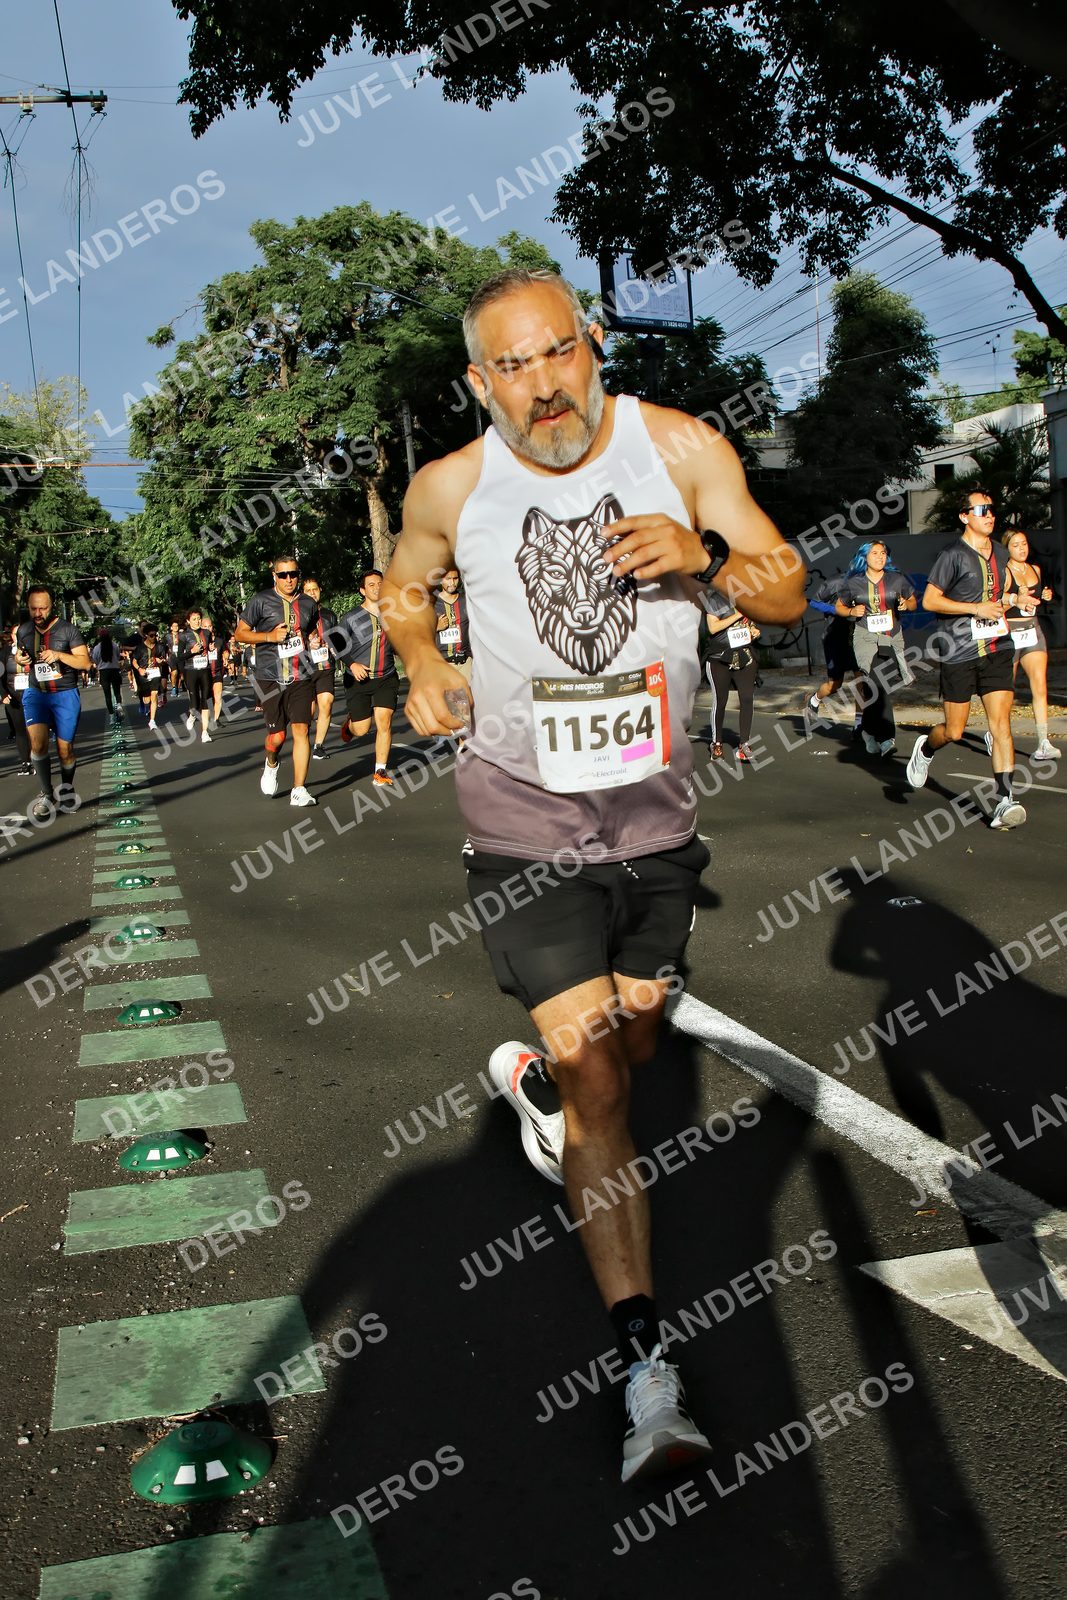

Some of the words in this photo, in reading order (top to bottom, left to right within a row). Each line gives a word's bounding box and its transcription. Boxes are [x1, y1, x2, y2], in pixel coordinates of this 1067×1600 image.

[37, 664, 55, 674] 905
[574, 682, 604, 691] NEGROS
[541, 704, 655, 752] 11564
